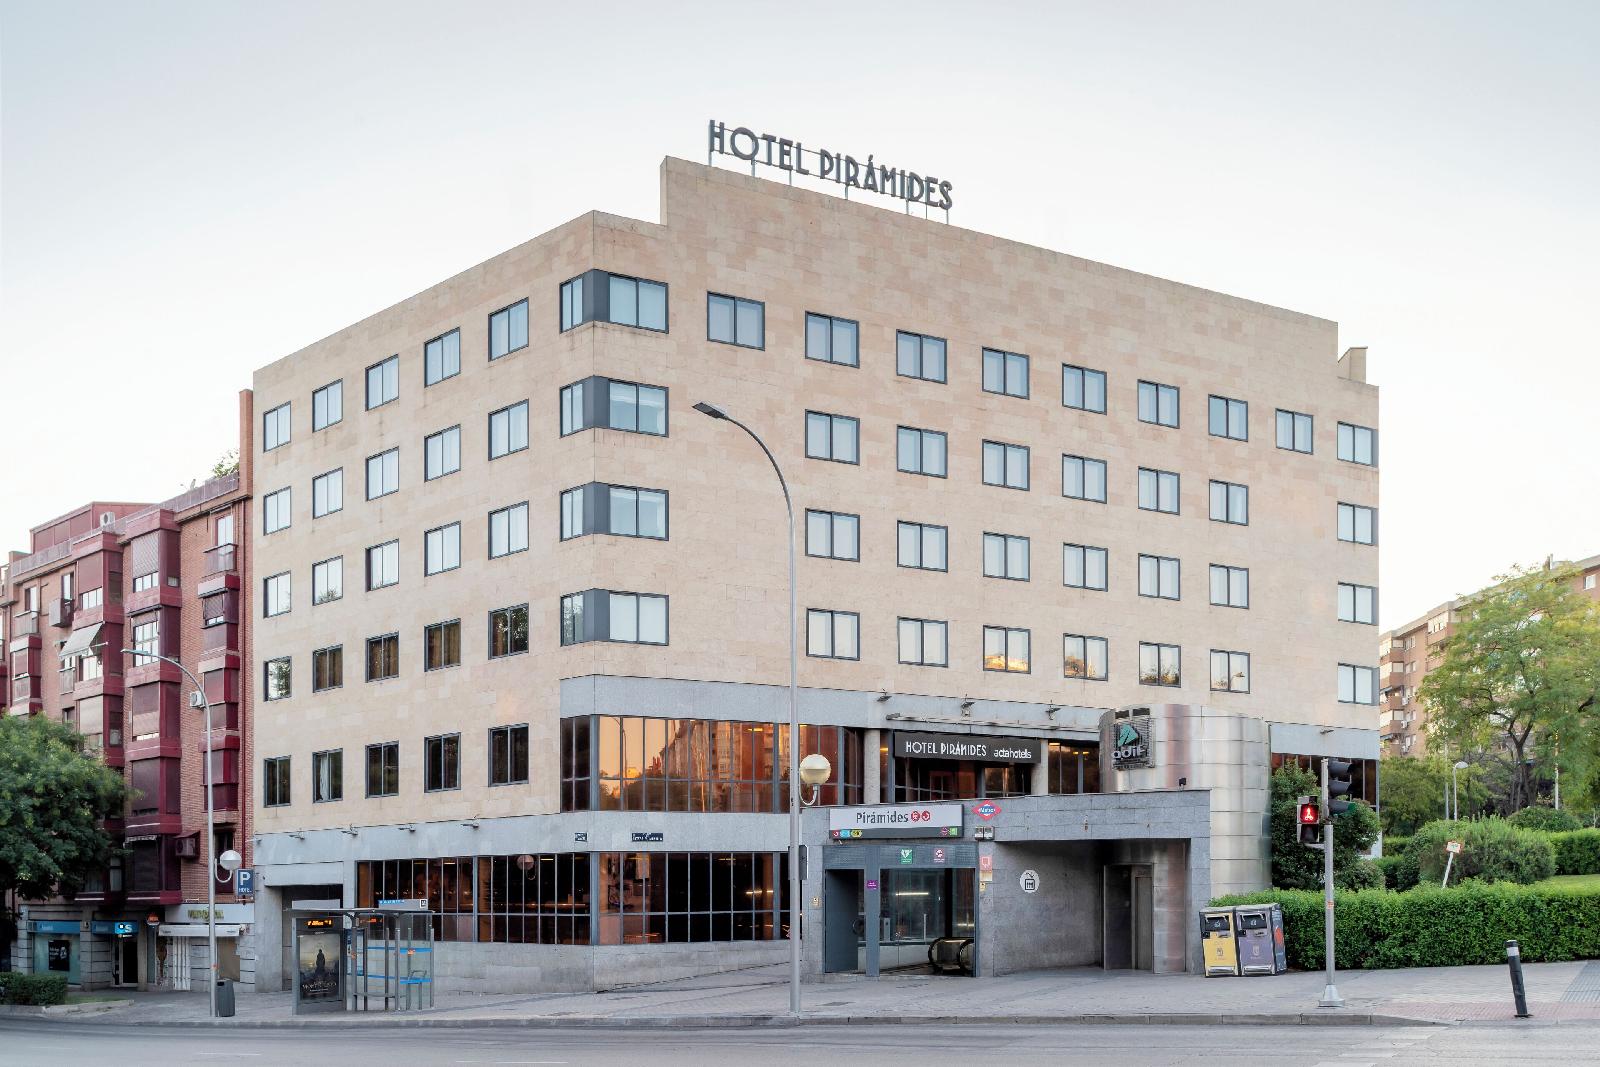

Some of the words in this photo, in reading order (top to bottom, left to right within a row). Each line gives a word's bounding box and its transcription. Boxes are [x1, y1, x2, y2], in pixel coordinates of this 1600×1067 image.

[708, 119, 810, 175] HOTEL
[819, 149, 953, 210] PIRÁMIDES
[905, 741, 938, 753] HOTEL
[940, 742, 987, 757] PIRÁMIDES
[856, 810, 909, 824] Pirámides
[240, 871, 251, 886] P
